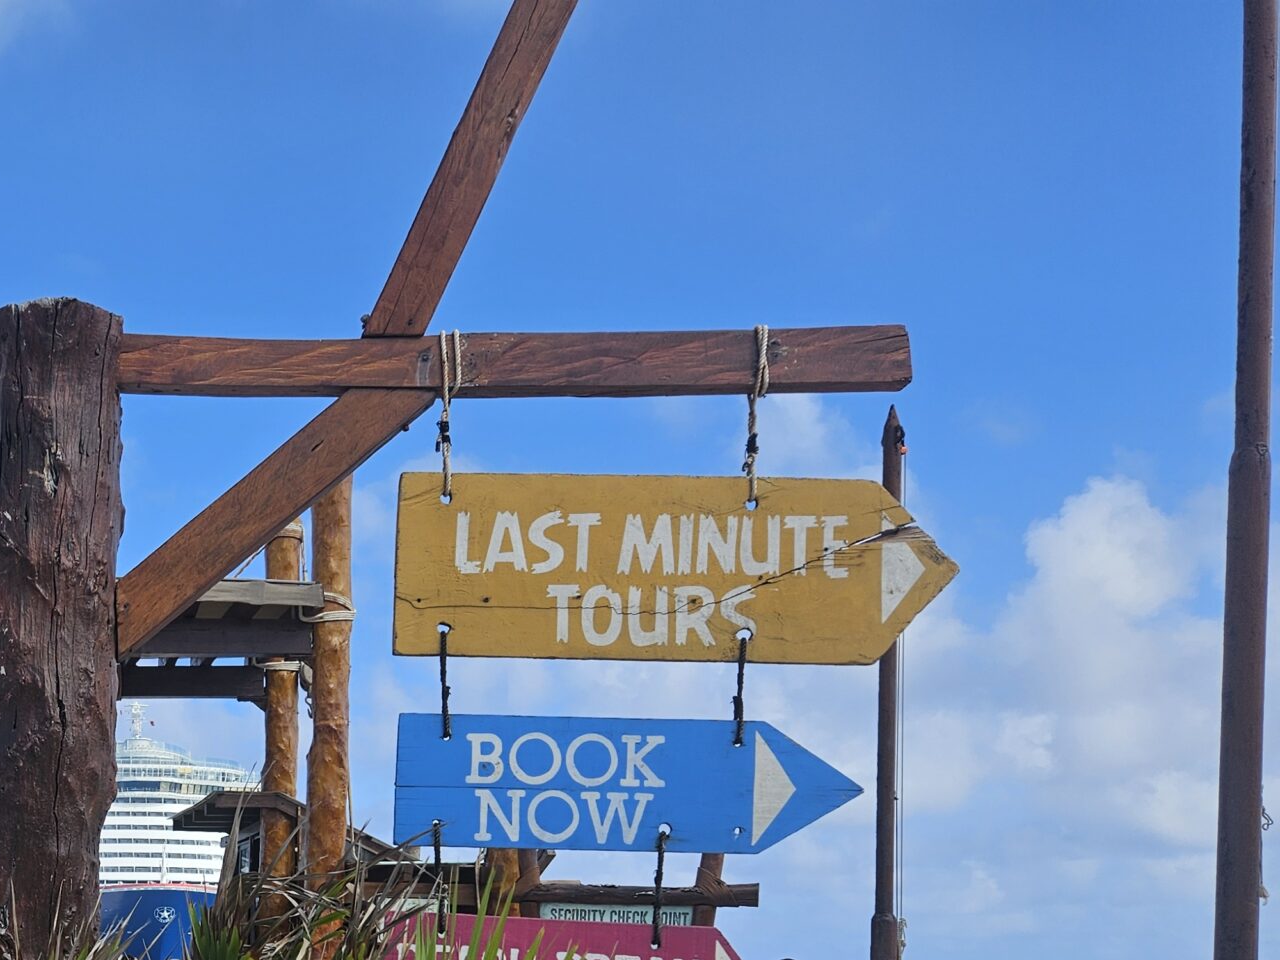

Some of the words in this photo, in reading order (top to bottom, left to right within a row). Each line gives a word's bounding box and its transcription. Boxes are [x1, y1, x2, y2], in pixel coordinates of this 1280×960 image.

[454, 509, 602, 574] LAST
[617, 513, 851, 579] MINUTE
[546, 583, 758, 648] TOURS
[465, 731, 666, 787] BOOK
[474, 788, 654, 845] NOW
[610, 910, 648, 924] CHECK
[660, 911, 690, 926] OINT
